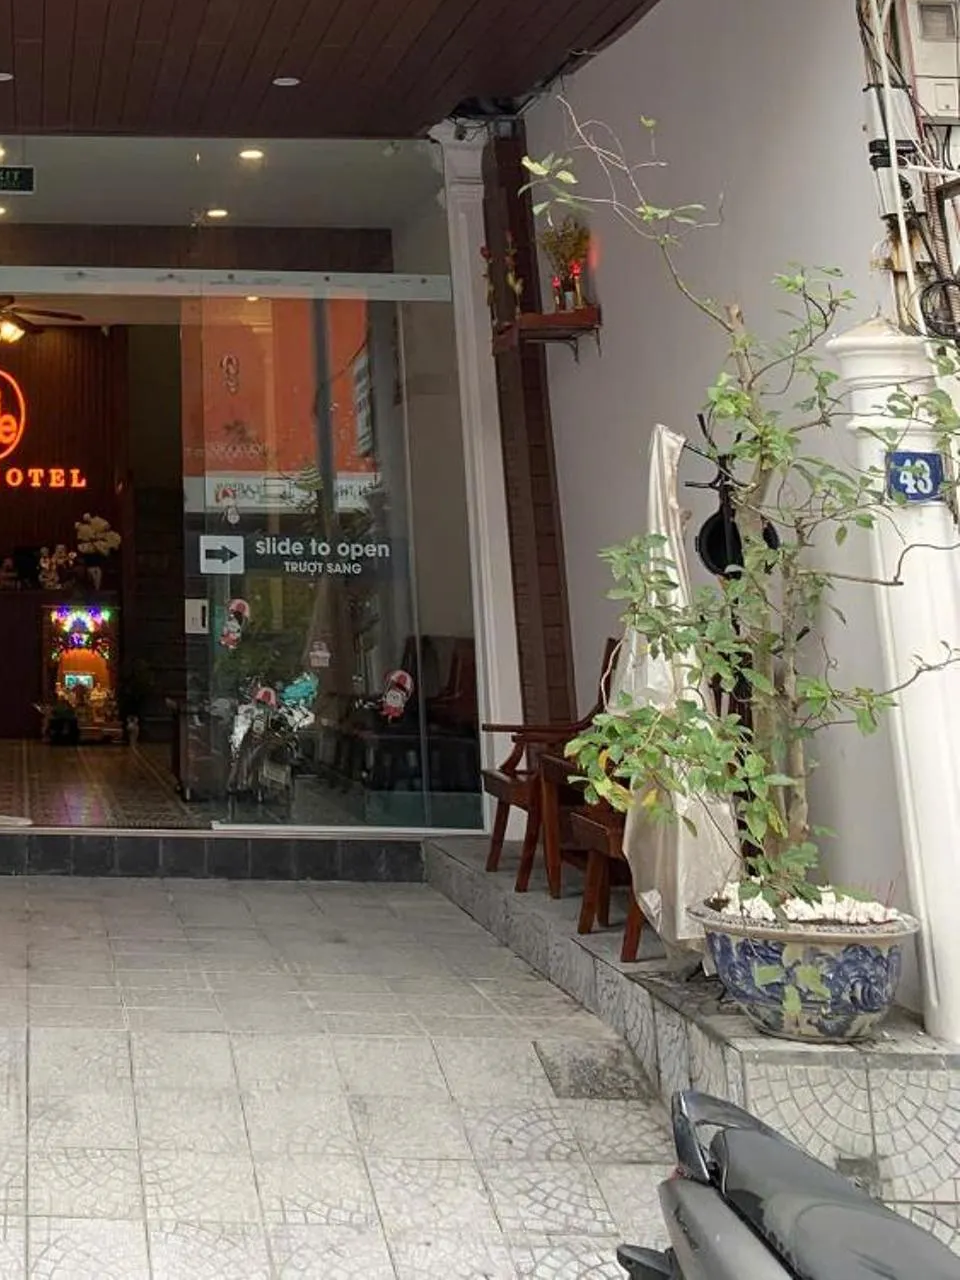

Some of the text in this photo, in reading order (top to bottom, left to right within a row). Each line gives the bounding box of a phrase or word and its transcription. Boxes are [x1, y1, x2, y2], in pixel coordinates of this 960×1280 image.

[900, 459, 933, 494] 43
[255, 537, 390, 561] slide to open
[327, 563, 362, 575] SANG
